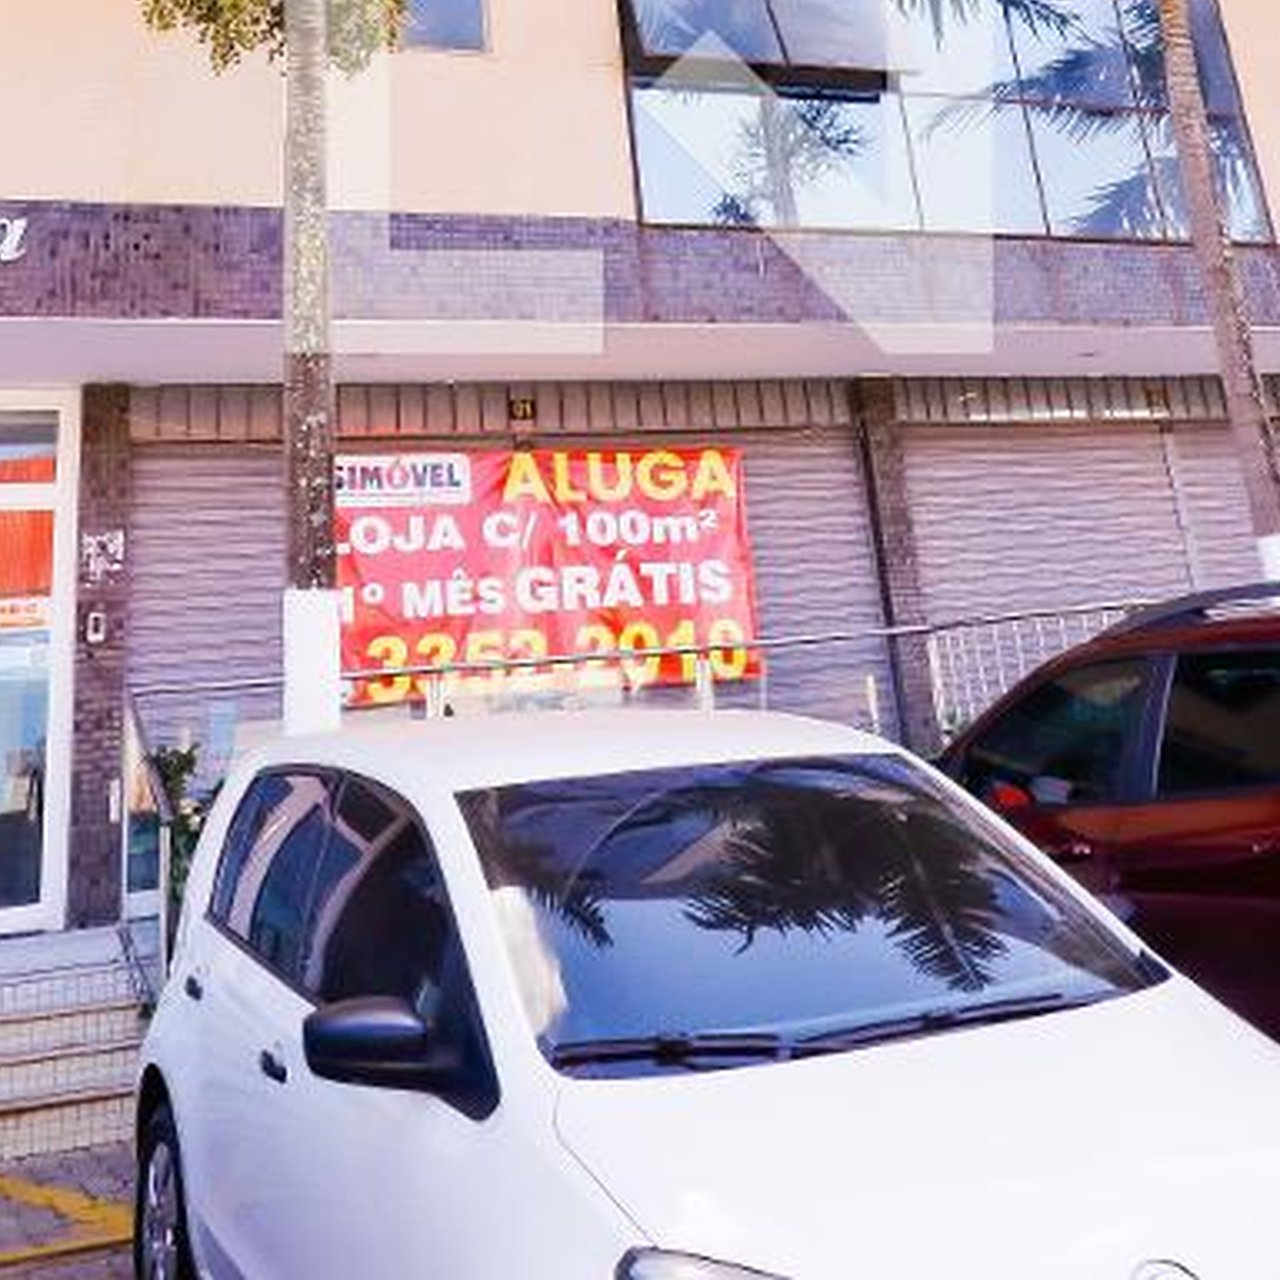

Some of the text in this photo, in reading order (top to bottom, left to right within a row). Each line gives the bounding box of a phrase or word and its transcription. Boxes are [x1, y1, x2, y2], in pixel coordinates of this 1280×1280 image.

[501, 450, 737, 502] ALUGA
[401, 568, 507, 619] MÊS
[516, 550, 734, 614] GRÁTIS
